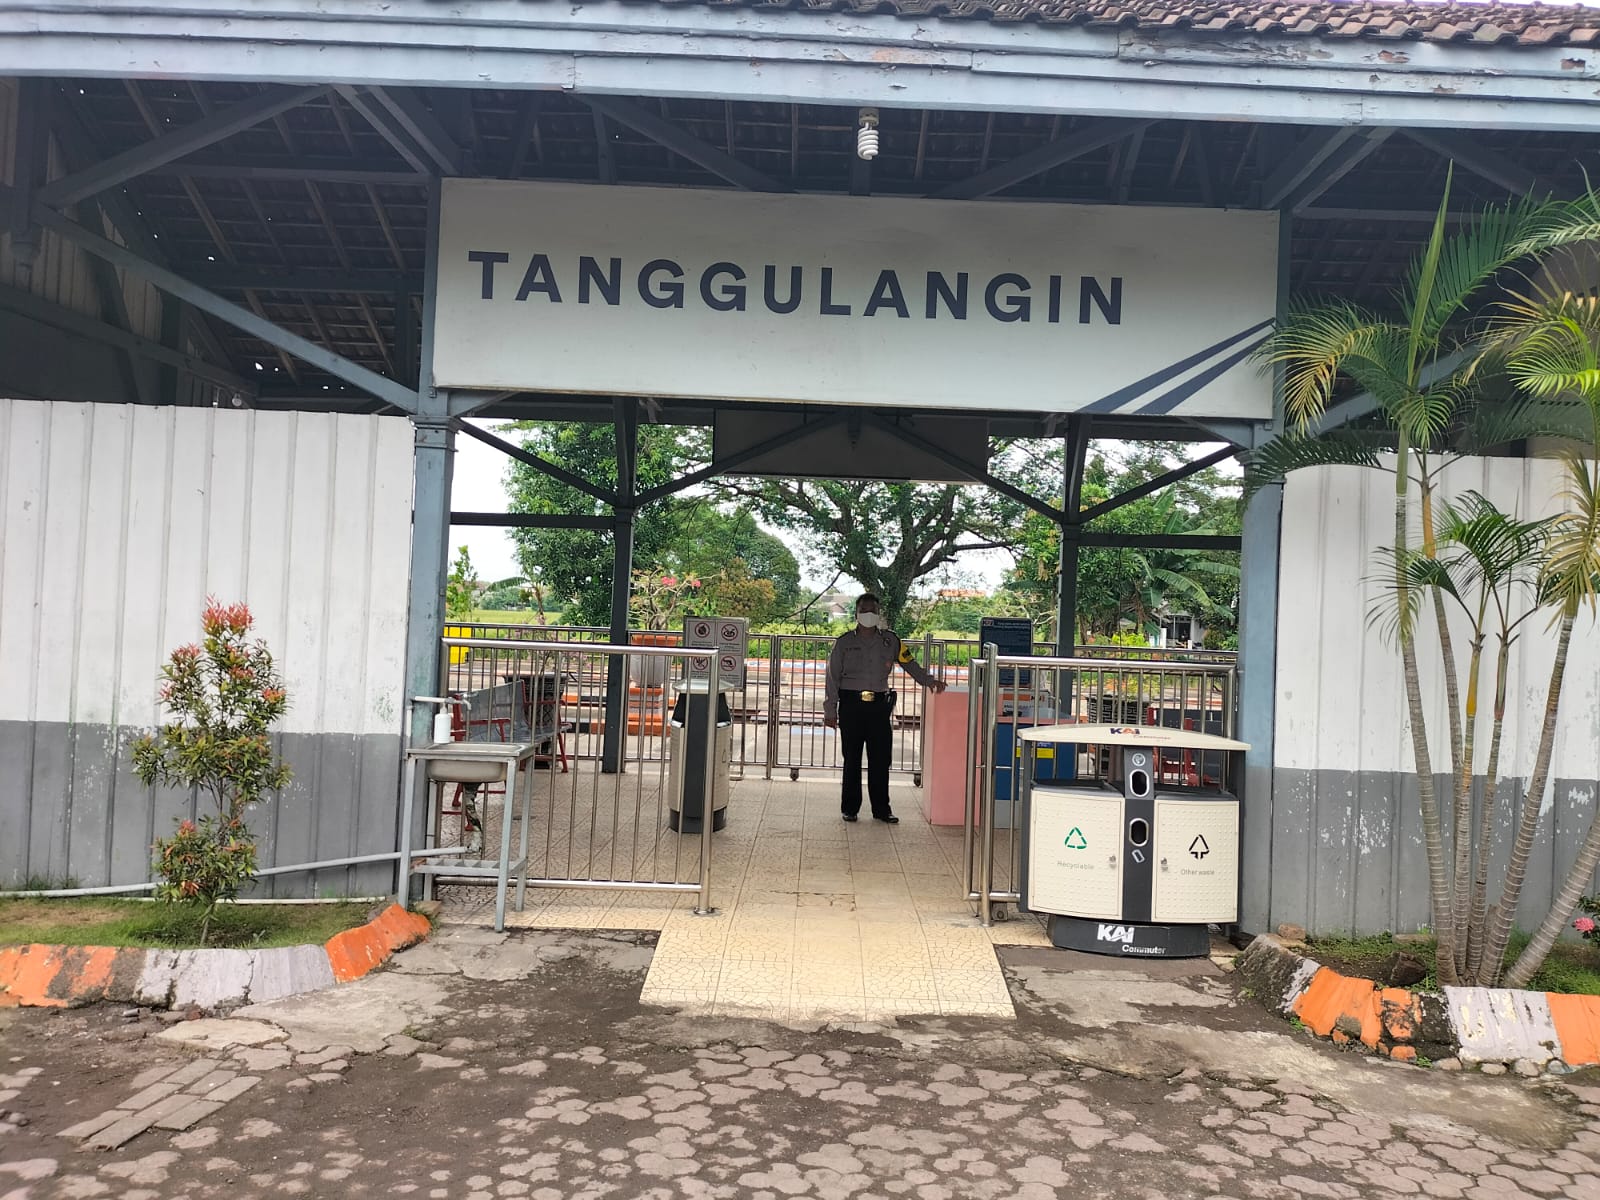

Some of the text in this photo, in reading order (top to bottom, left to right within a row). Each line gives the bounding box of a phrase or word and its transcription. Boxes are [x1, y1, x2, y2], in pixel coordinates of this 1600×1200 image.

[468, 251, 1122, 325] TANGGULANGIN
[1097, 924, 1135, 943] KAI
[1122, 944, 1167, 954] Commuter
